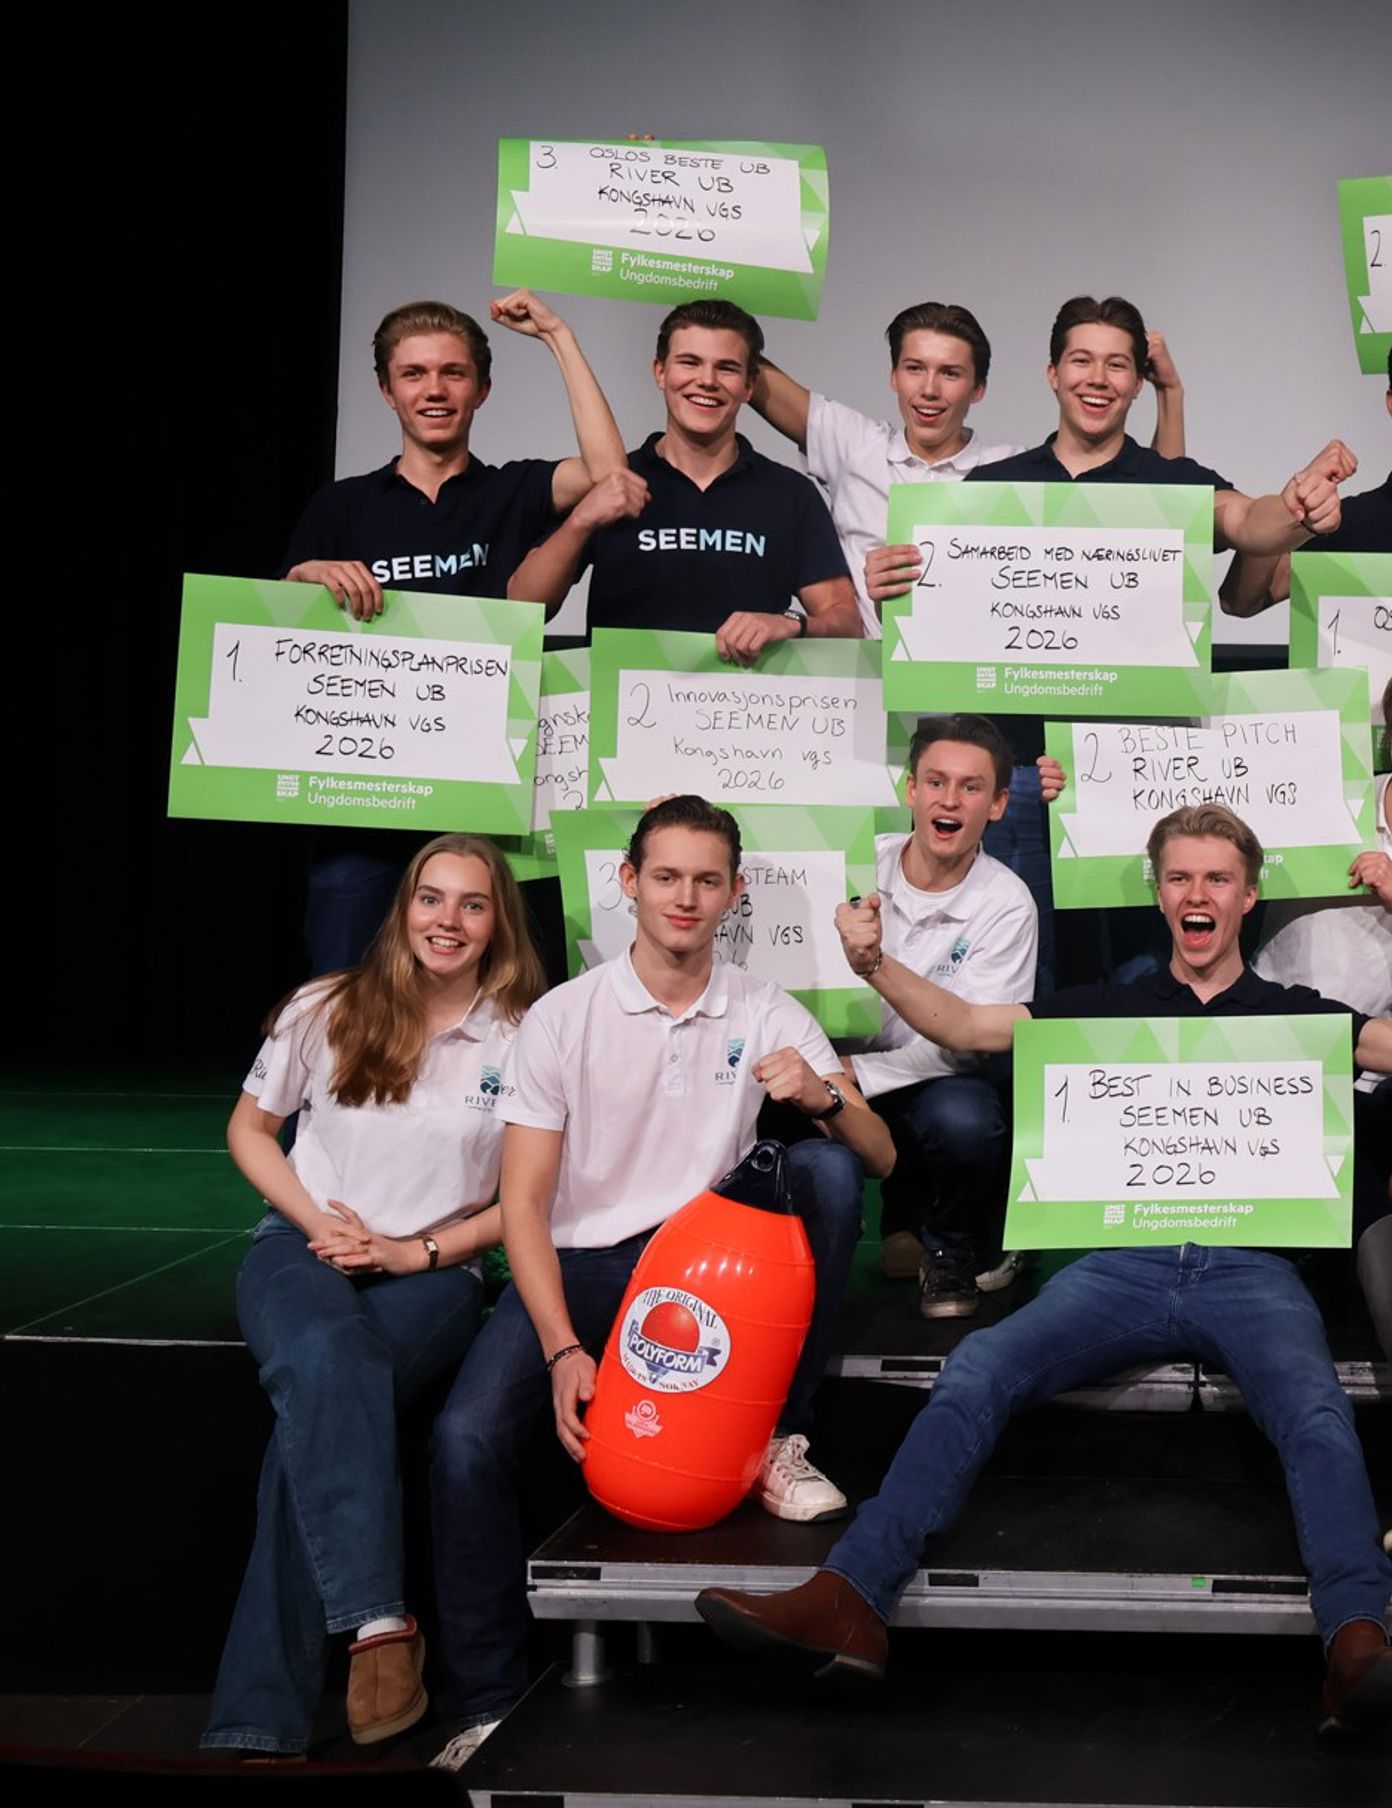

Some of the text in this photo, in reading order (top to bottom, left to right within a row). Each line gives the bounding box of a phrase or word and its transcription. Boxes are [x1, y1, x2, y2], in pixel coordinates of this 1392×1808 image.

[589, 147, 651, 162] OSLOS
[664, 153, 723, 169] BESTE
[740, 161, 770, 175] UB
[609, 162, 734, 193] RIVER UB
[598, 185, 742, 220] KONGSHAVN VGS
[621, 252, 734, 279] Fylkesmesterskap
[619, 268, 718, 292] Ungdomsbedrift
[638, 528, 766, 557] SEEMEN
[947, 538, 1031, 561] SAMARBEID
[1044, 548, 1075, 561] MED
[1081, 548, 1182, 562] NÆRINGSLIVET
[372, 543, 489, 583] SEEMEN
[991, 566, 1139, 590] SEEMEN UB
[991, 602, 1120, 620] KONGSHAVN VGS
[1005, 626, 1078, 650] 2026
[275, 639, 508, 676] FORRETNINGSPLANPRISEN
[1005, 667, 1118, 682] Fylkesmesterskap
[307, 674, 446, 701] SEEMEN UB
[1004, 683, 1102, 696] Ungdomsbedrift
[627, 682, 656, 729] 2
[667, 683, 858, 711] Innovasjonsprisen
[295, 705, 446, 732] KONGSHAVN VGS
[696, 709, 846, 737] SEEMEN UB
[315, 734, 394, 759] 2026
[673, 736, 832, 770] Kongshavn vgs
[1081, 722, 1297, 783] 2 BESTE PITCH
[717, 768, 784, 790] 2026
[1133, 757, 1248, 782] RIVER UB
[309, 776, 434, 796] Fylkesmesterskap
[1132, 783, 1298, 810] KONGSHAVN VGS
[308, 793, 416, 810] Ungdomsbedrift
[771, 925, 804, 946] VGS
[1088, 1069, 1152, 1099] BEST
[1169, 1079, 1191, 1097] IN
[1207, 1076, 1314, 1096] BUSINESS
[1120, 1106, 1272, 1127] SEEMEN UB
[1124, 1136, 1280, 1157] KONGSHAVN VGS
[1127, 1163, 1216, 1186] 2026
[1134, 1203, 1254, 1215] Fylkesmesterskap
[1132, 1216, 1237, 1231] Ungdomsbedrift
[666, 1289, 718, 1329] ORIGINAL
[629, 1335, 702, 1373] POLYFORM
